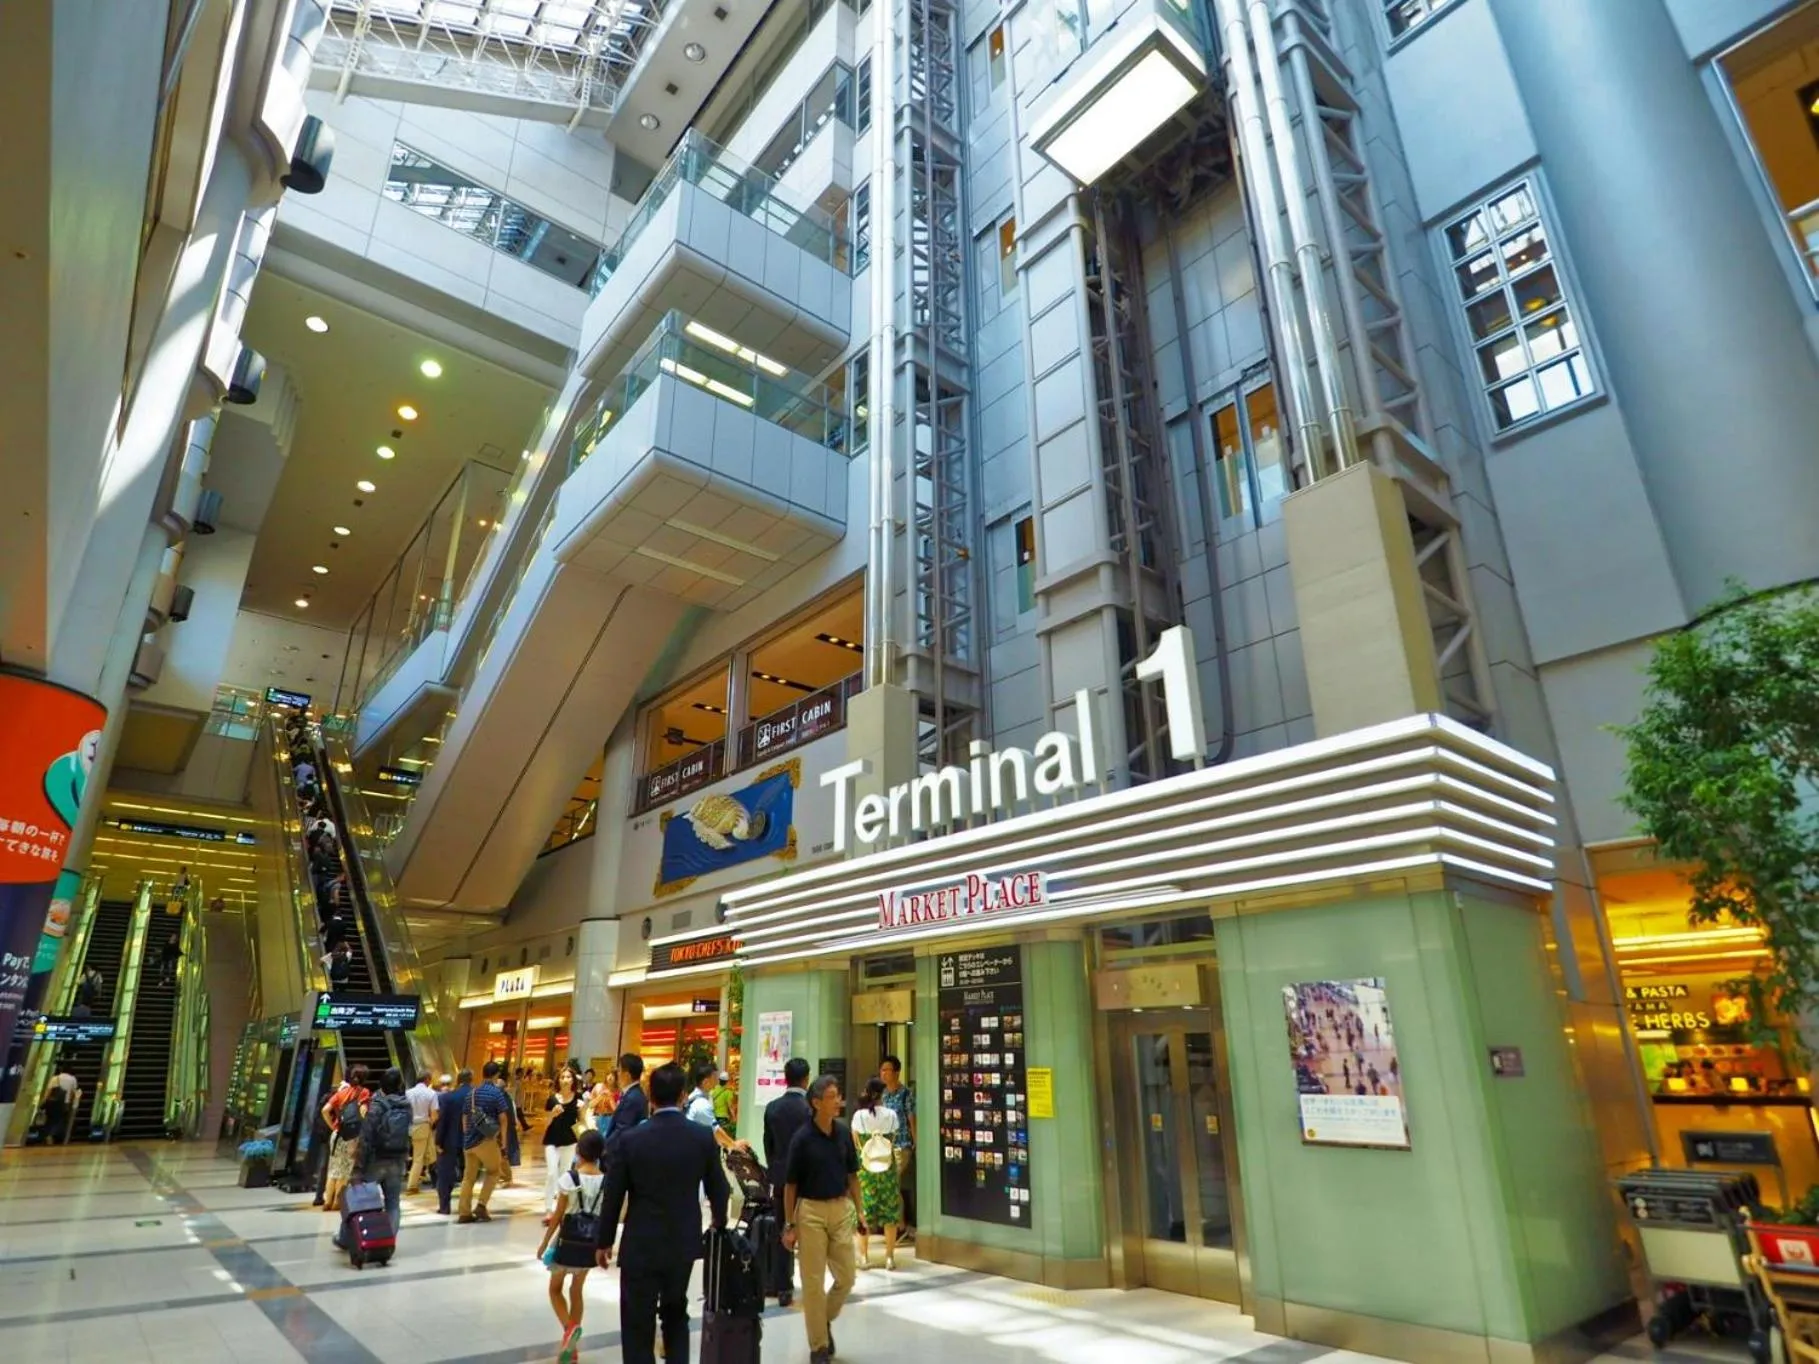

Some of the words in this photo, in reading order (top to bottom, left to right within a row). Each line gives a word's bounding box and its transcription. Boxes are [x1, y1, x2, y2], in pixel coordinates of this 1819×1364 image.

[772, 716, 797, 739] FIRST
[802, 700, 831, 725] CABIN
[820, 688, 1097, 852] Terminal
[1136, 625, 1205, 762] 1
[661, 771, 678, 789] FIRST
[682, 760, 703, 779] CABIN
[878, 887, 961, 930] MARKET
[965, 871, 1043, 914] PLACE
[1626, 987, 1637, 999] &
[1641, 986, 1687, 998] PASTA
[1644, 1011, 1710, 1030] HERBS
